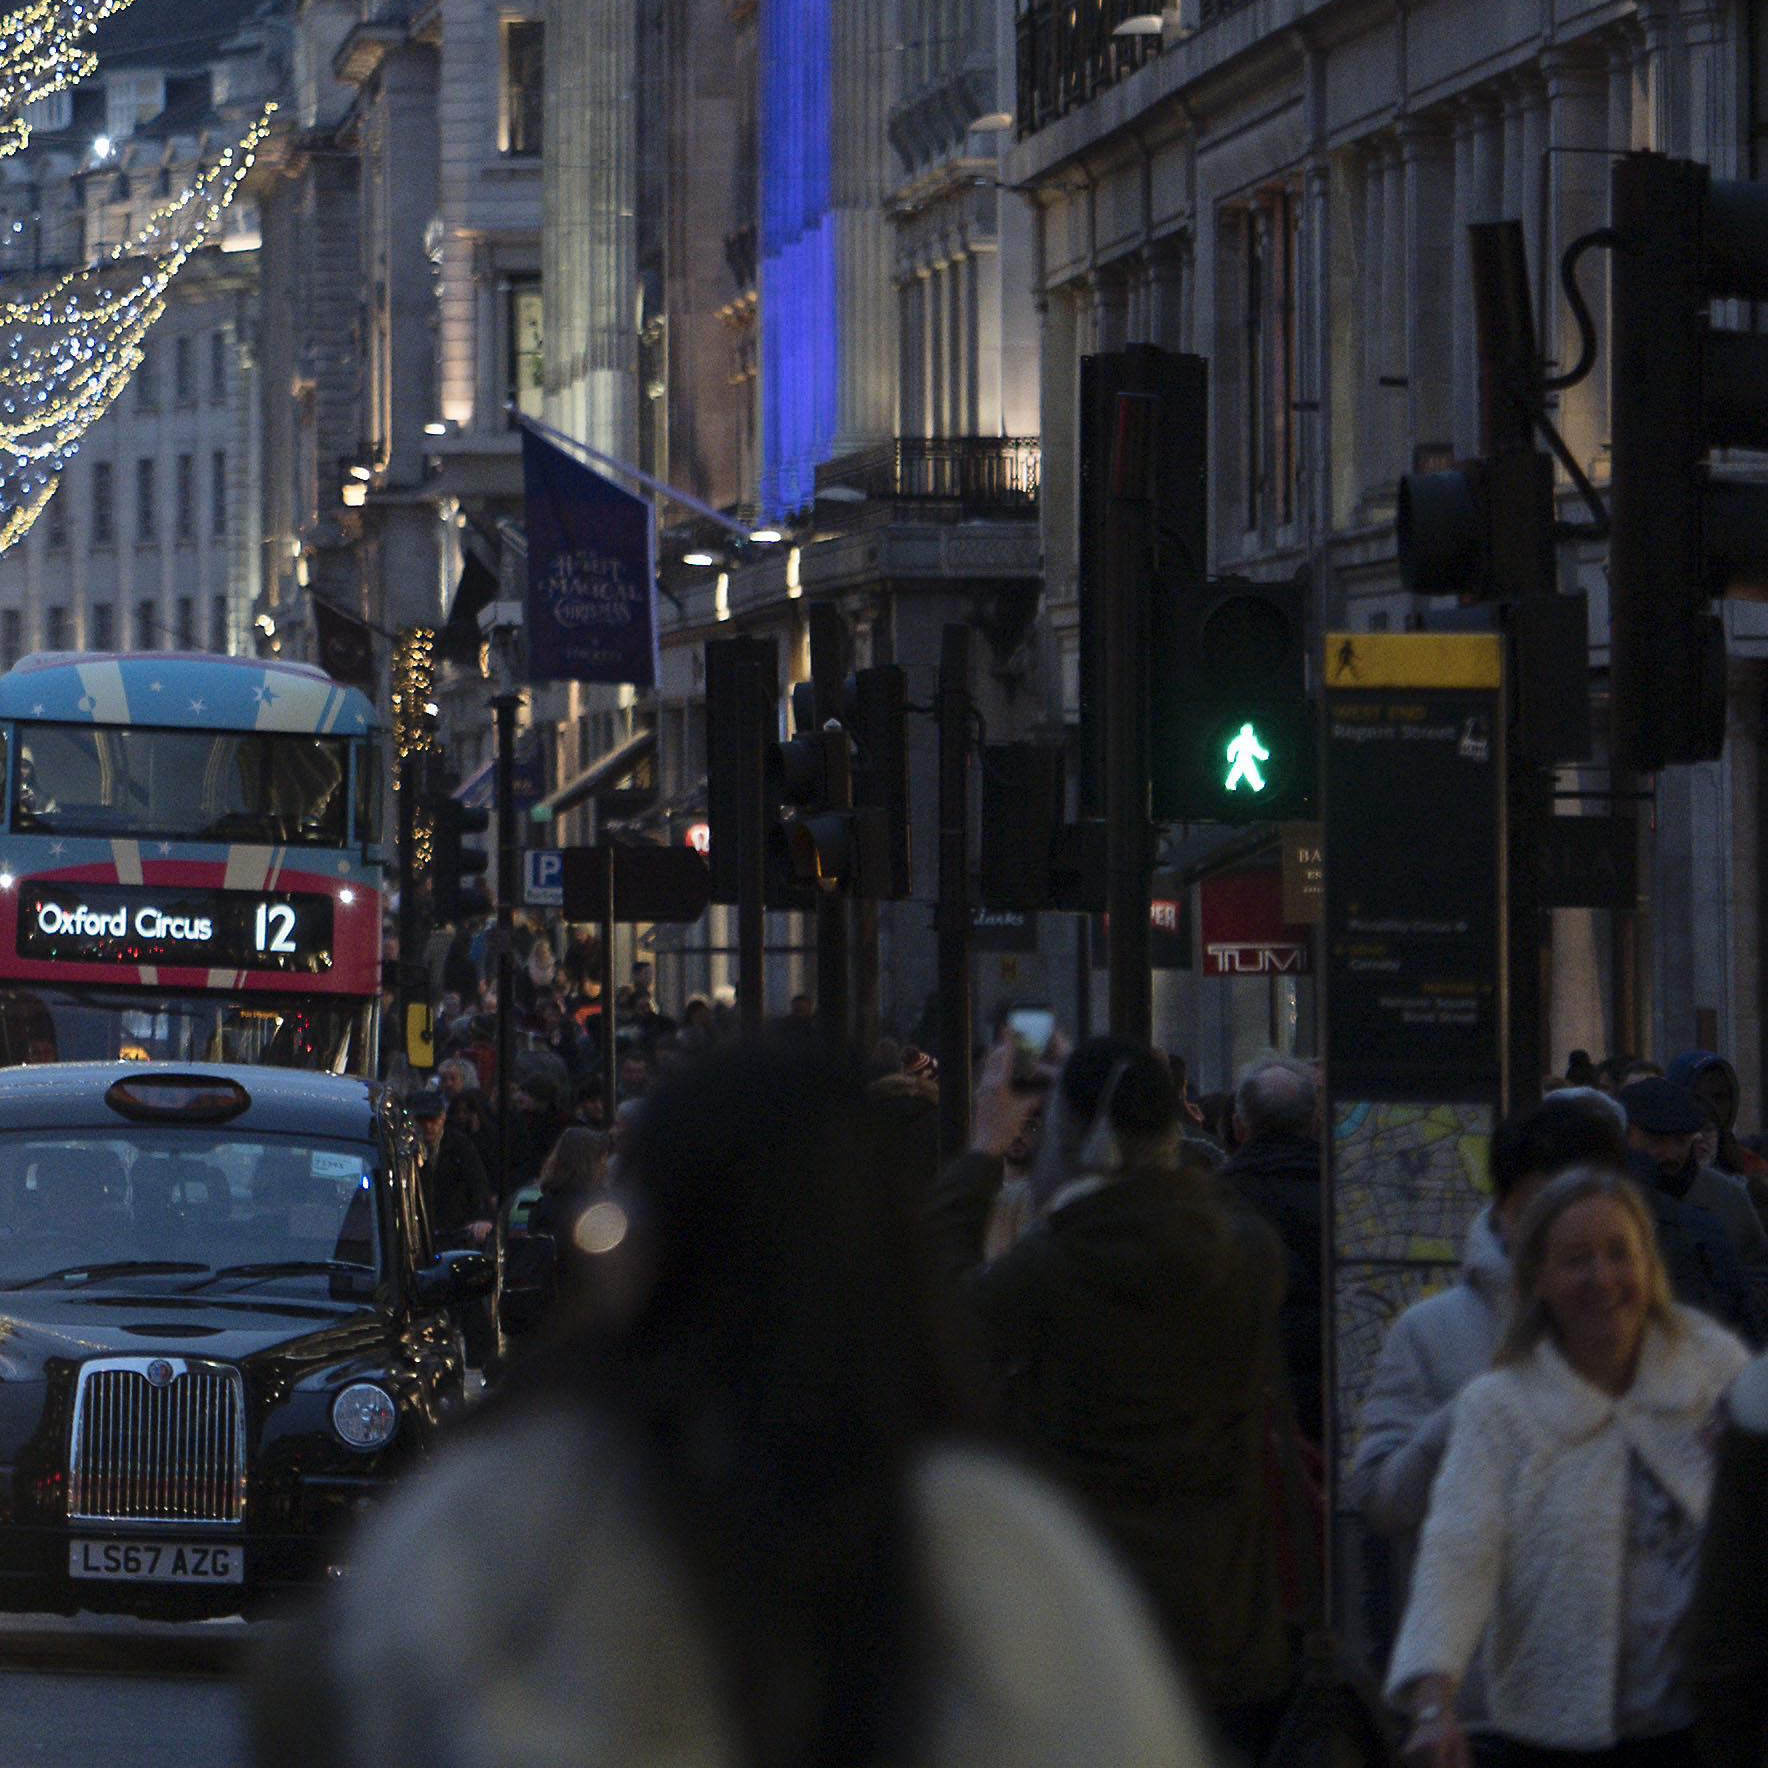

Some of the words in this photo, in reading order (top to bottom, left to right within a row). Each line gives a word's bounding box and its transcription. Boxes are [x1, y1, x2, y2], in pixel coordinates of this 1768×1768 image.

[539, 855, 561, 886] P
[38, 902, 128, 938] Oxford
[134, 906, 213, 941] Circus
[254, 903, 298, 953] 12
[1206, 941, 1308, 973] TUMI
[82, 1544, 162, 1574] LS67
[172, 1547, 230, 1576] AZG
